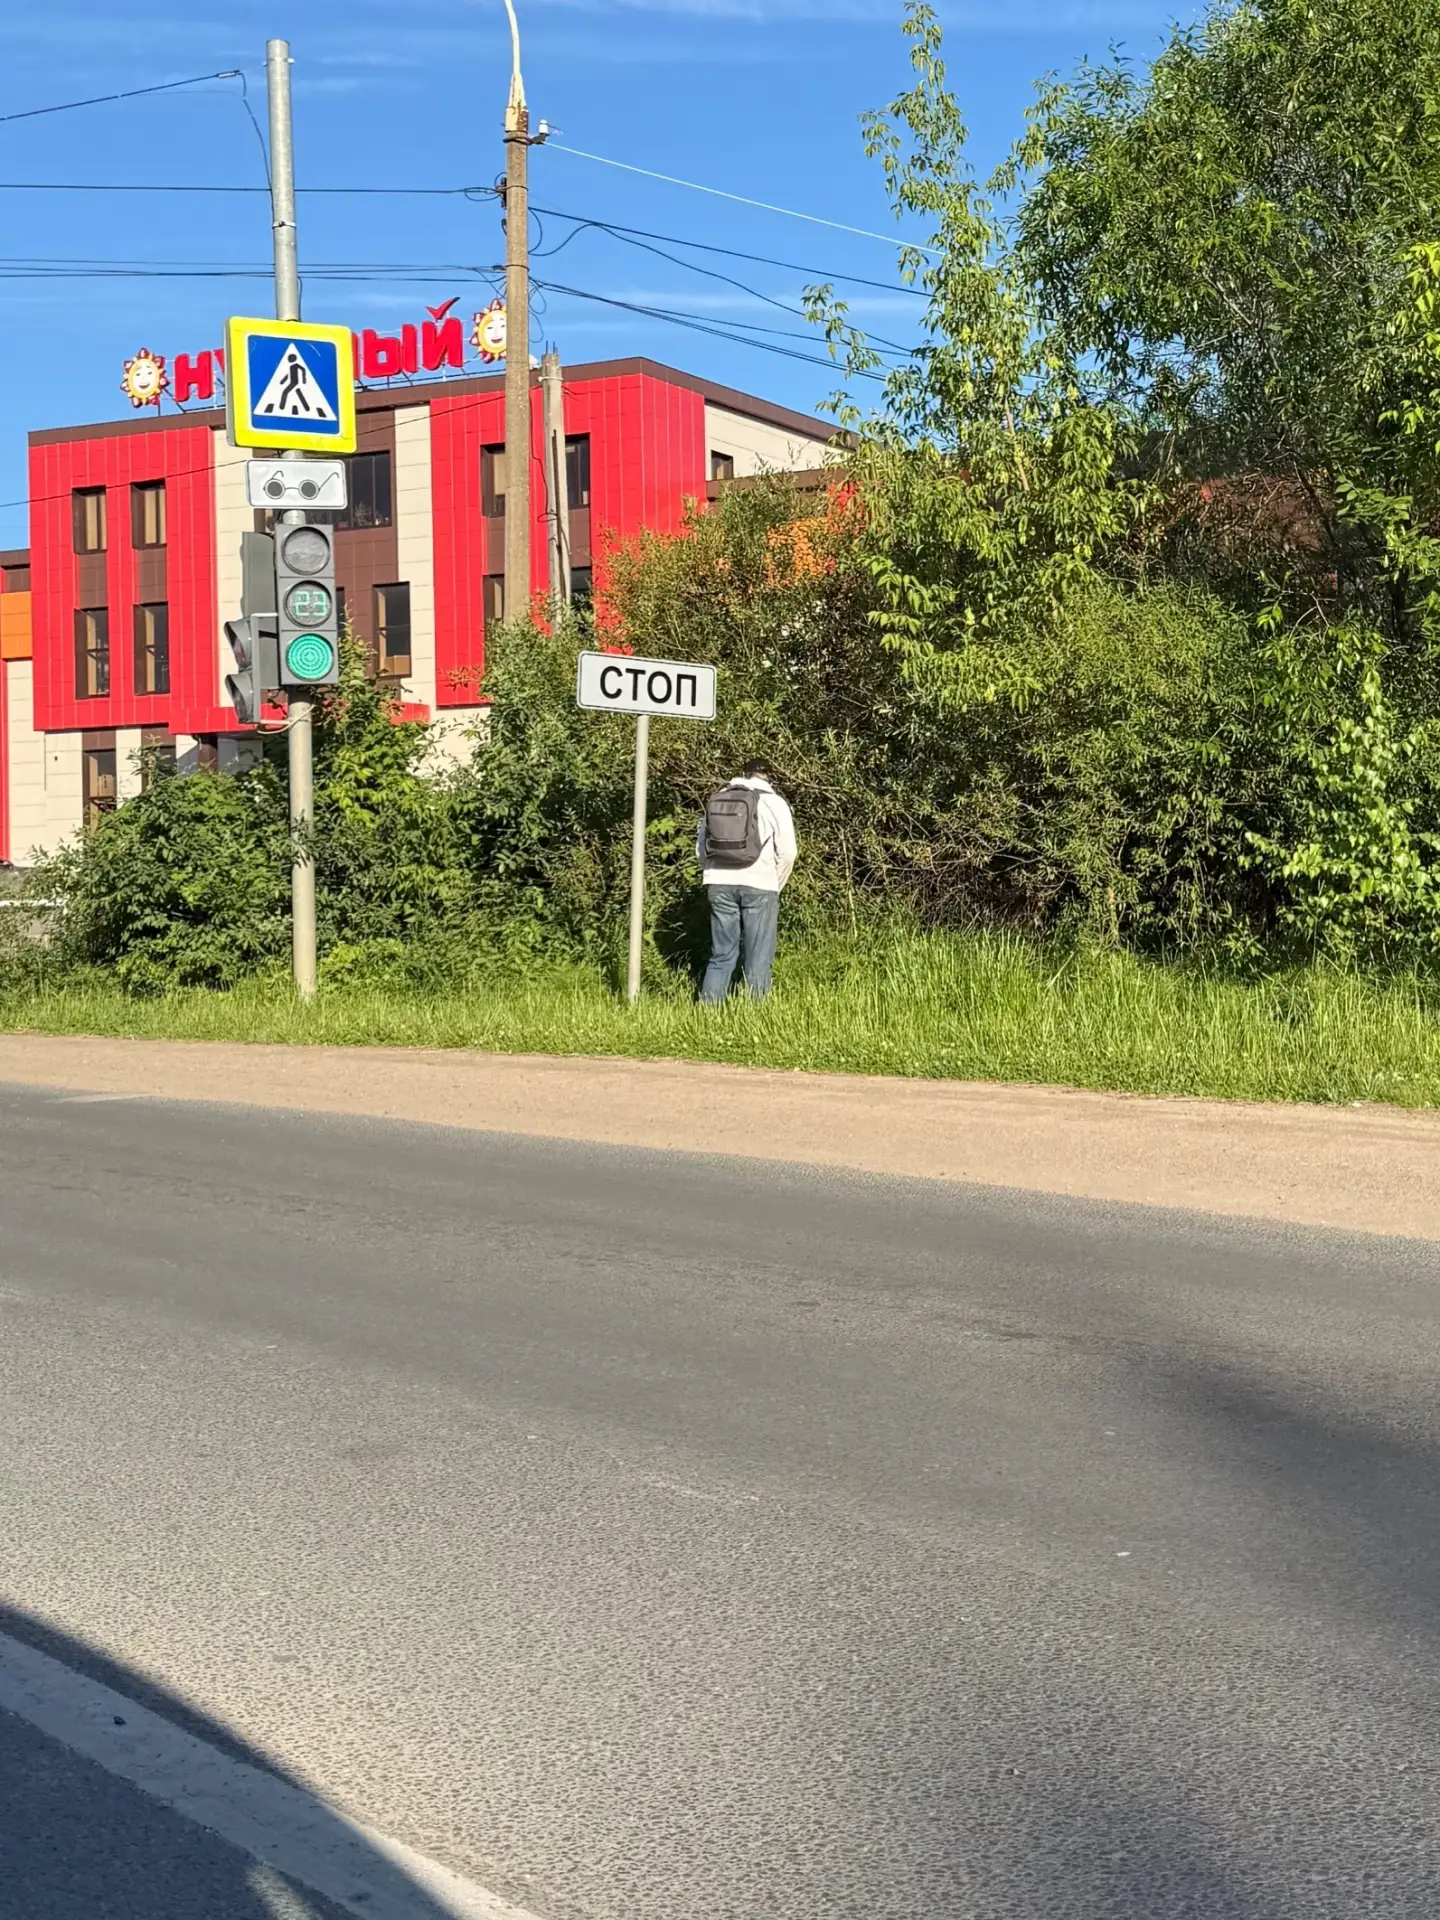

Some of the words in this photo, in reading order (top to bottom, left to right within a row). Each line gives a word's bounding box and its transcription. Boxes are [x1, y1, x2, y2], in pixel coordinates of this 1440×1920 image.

[175, 297, 463, 402] НЫЙ
[296, 591, 326, 616] 23
[600, 666, 696, 707] СТОП
